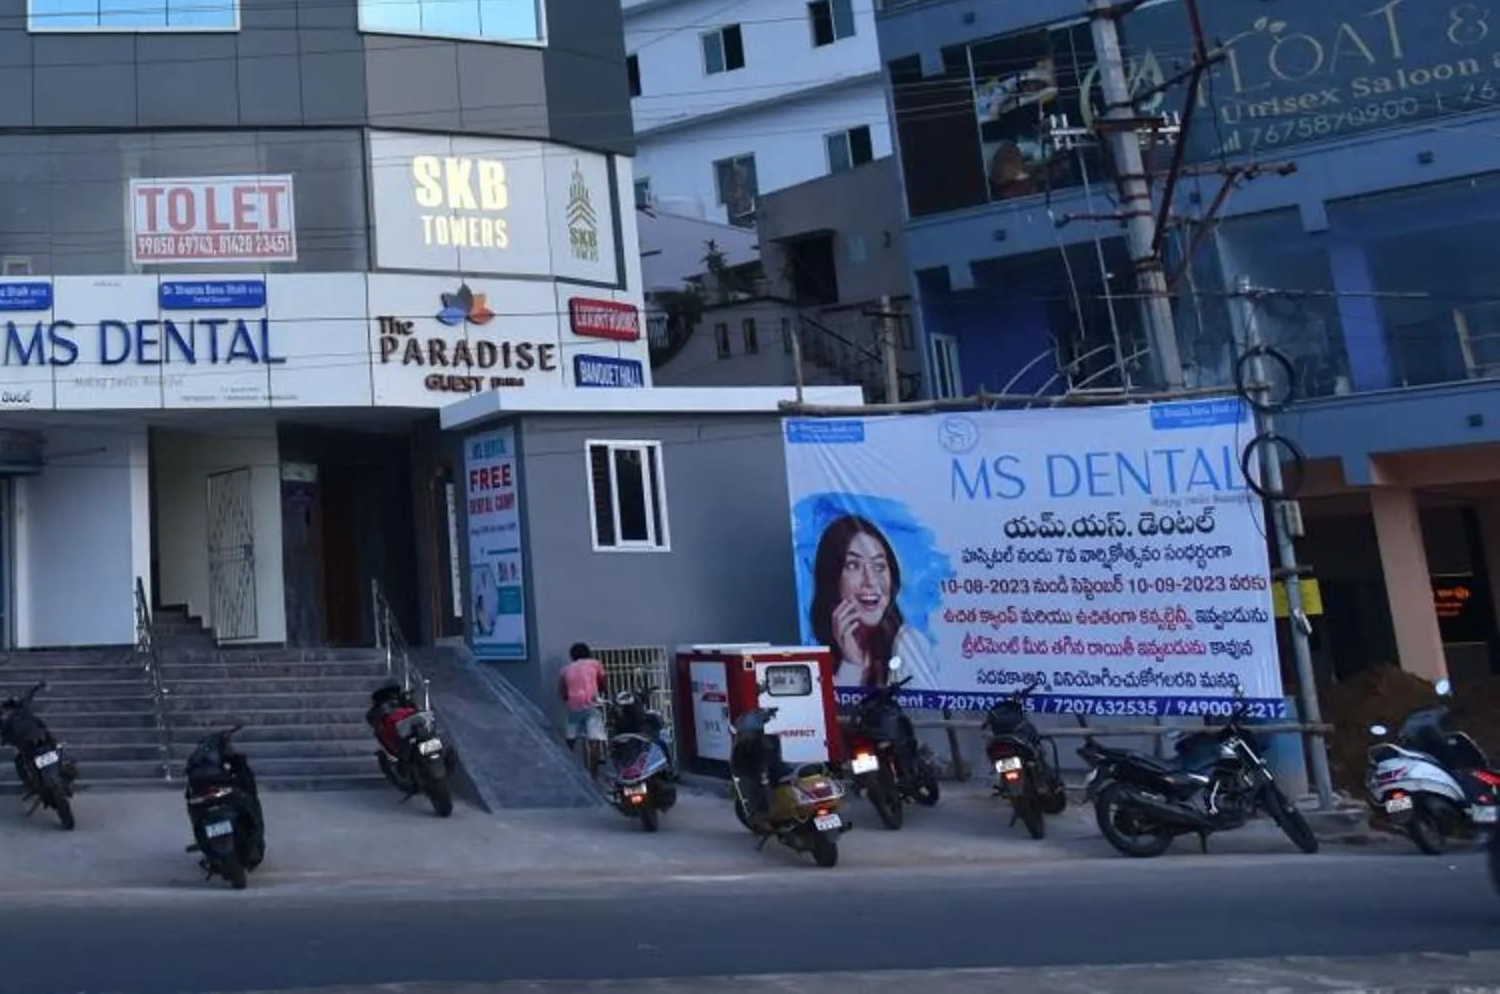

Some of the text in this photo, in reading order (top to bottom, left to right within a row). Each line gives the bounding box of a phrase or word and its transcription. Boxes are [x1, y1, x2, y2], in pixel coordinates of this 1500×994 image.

[1351, 57, 1480, 97] Saloon
[412, 155, 508, 210] SKB
[137, 185, 285, 232] TO LET
[421, 216, 509, 249] TOWERS
[3, 318, 286, 366] MS DENTAL
[377, 316, 415, 335] The
[379, 336, 557, 371] PARADISE
[424, 374, 484, 393] GUEST
[469, 463, 513, 493] FREE
[951, 444, 1248, 501] MS DENTAL
[941, 578, 1029, 594] 10-08-2023
[1128, 576, 1226, 594] 10-09-2023
[1054, 698, 1157, 715] 7207632535
